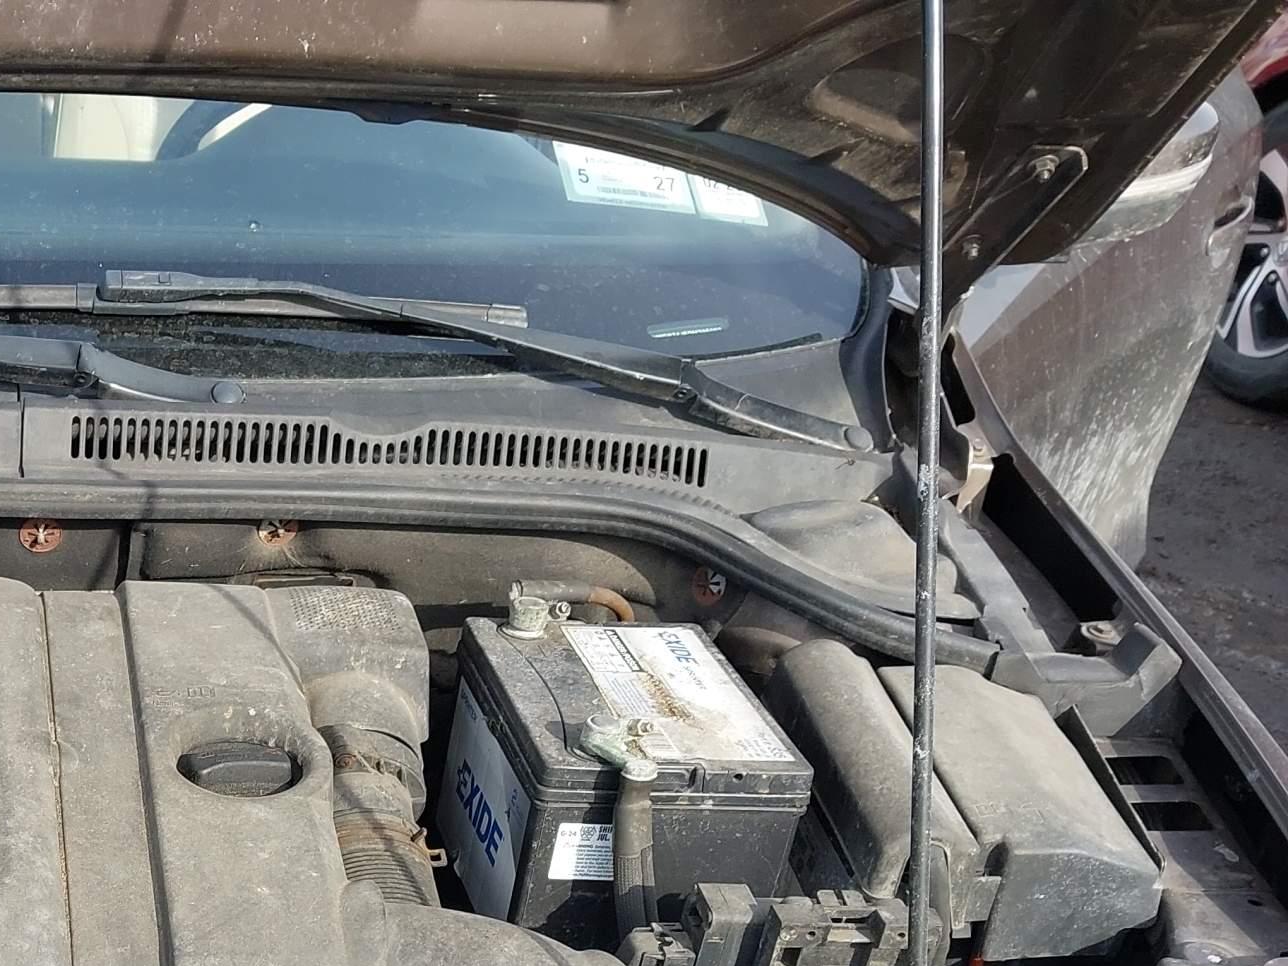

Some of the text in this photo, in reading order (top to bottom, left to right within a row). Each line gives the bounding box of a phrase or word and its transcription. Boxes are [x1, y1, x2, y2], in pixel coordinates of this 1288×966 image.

[577, 168, 590, 184] 5
[653, 176, 675, 192] 27
[658, 630, 699, 666] EXIDE
[455, 758, 504, 868] EXIDE
